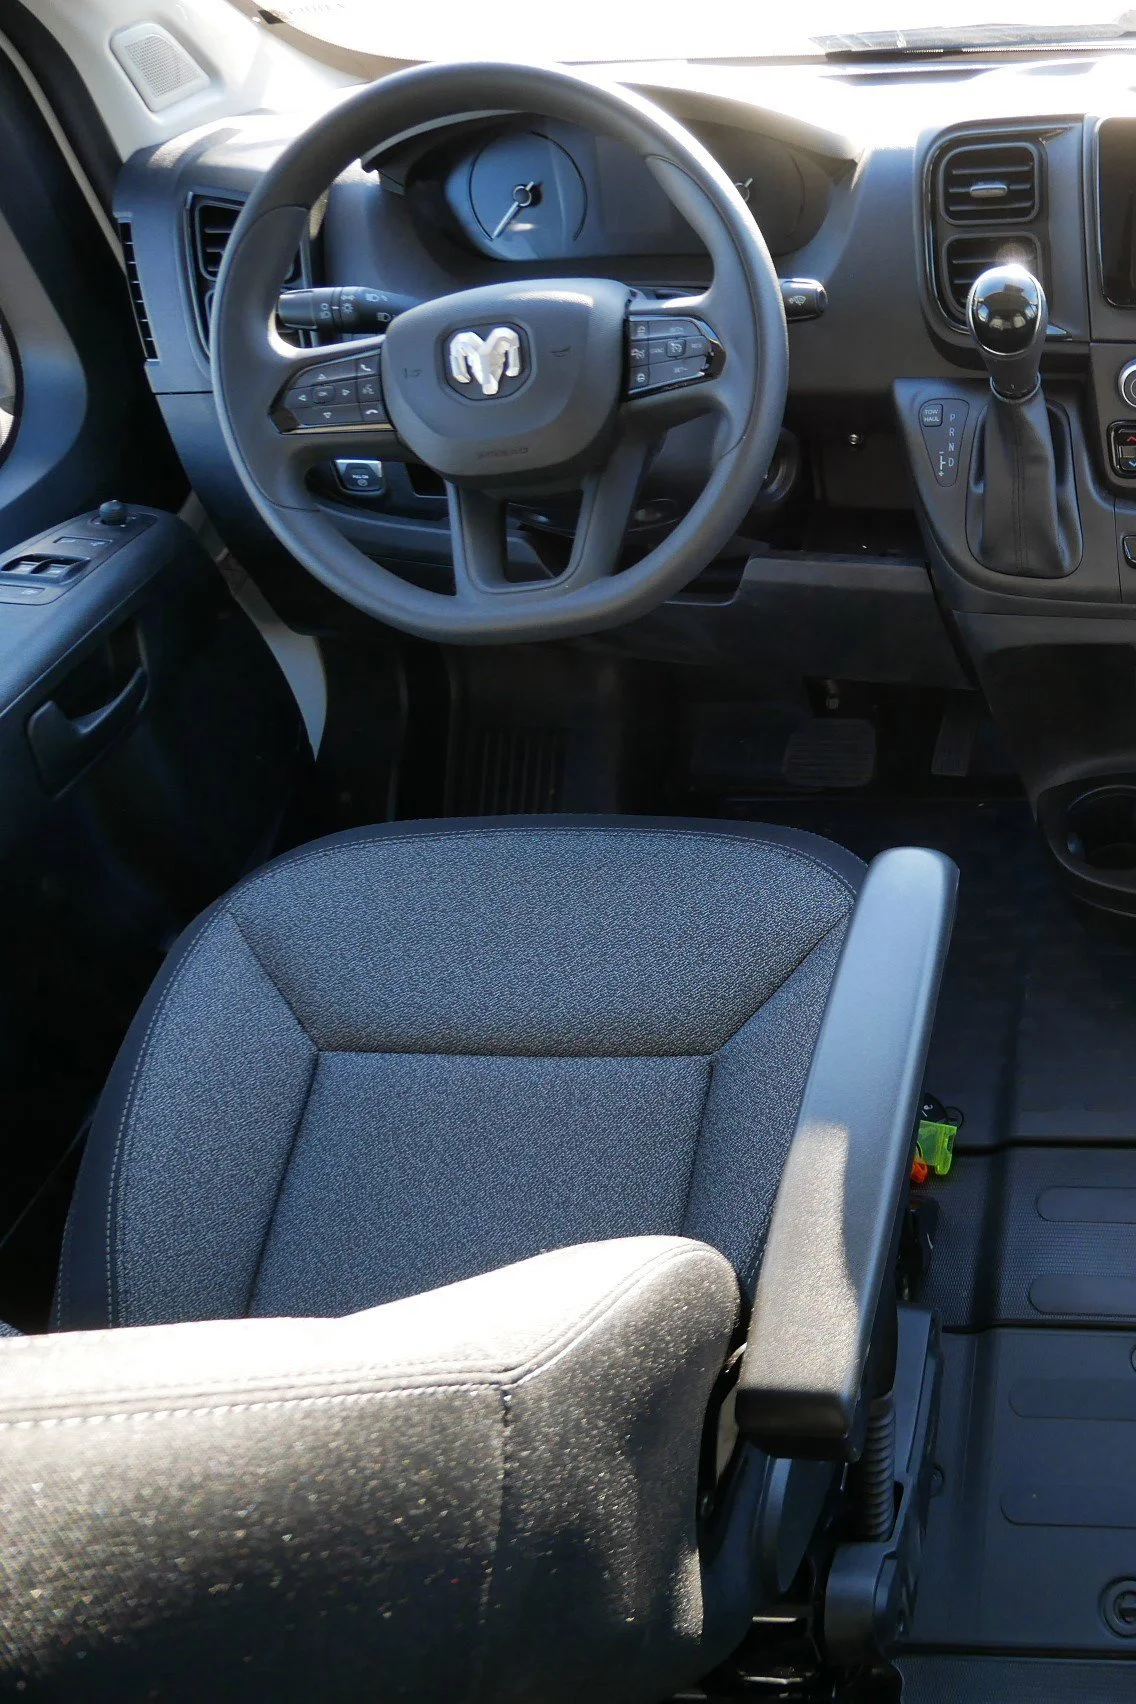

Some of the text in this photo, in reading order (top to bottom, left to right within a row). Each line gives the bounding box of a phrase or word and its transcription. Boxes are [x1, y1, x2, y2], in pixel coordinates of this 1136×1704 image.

[949, 428, 955, 437] R
[948, 443, 955, 451] N
[948, 458, 954, 467] D
